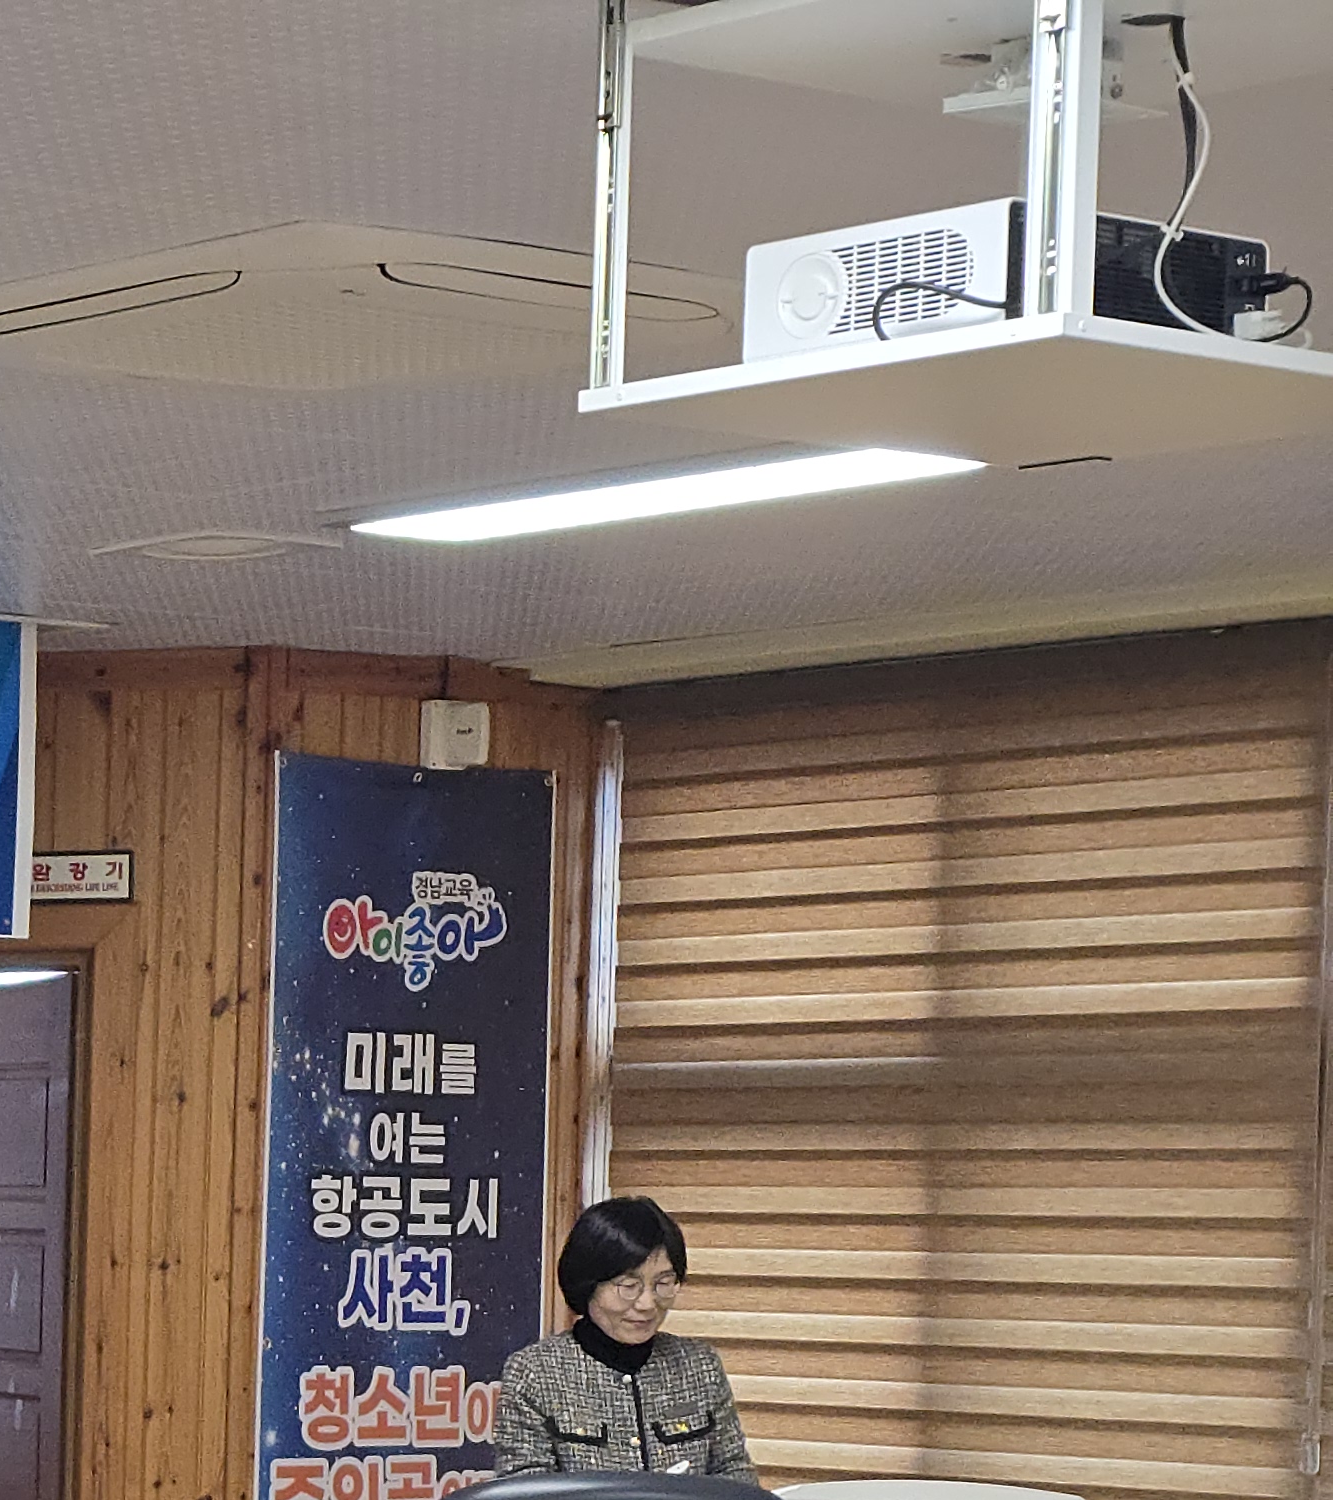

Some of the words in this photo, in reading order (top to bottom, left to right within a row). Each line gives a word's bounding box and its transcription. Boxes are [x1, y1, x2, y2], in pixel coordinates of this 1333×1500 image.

[415, 876, 474, 901] 경남교육
[326, 901, 505, 986] 아이좋아
[344, 1032, 477, 1095] 미래를
[370, 1112, 446, 1164] 여는
[311, 1174, 500, 1239] 항공도시
[338, 1247, 470, 1336] 사천,
